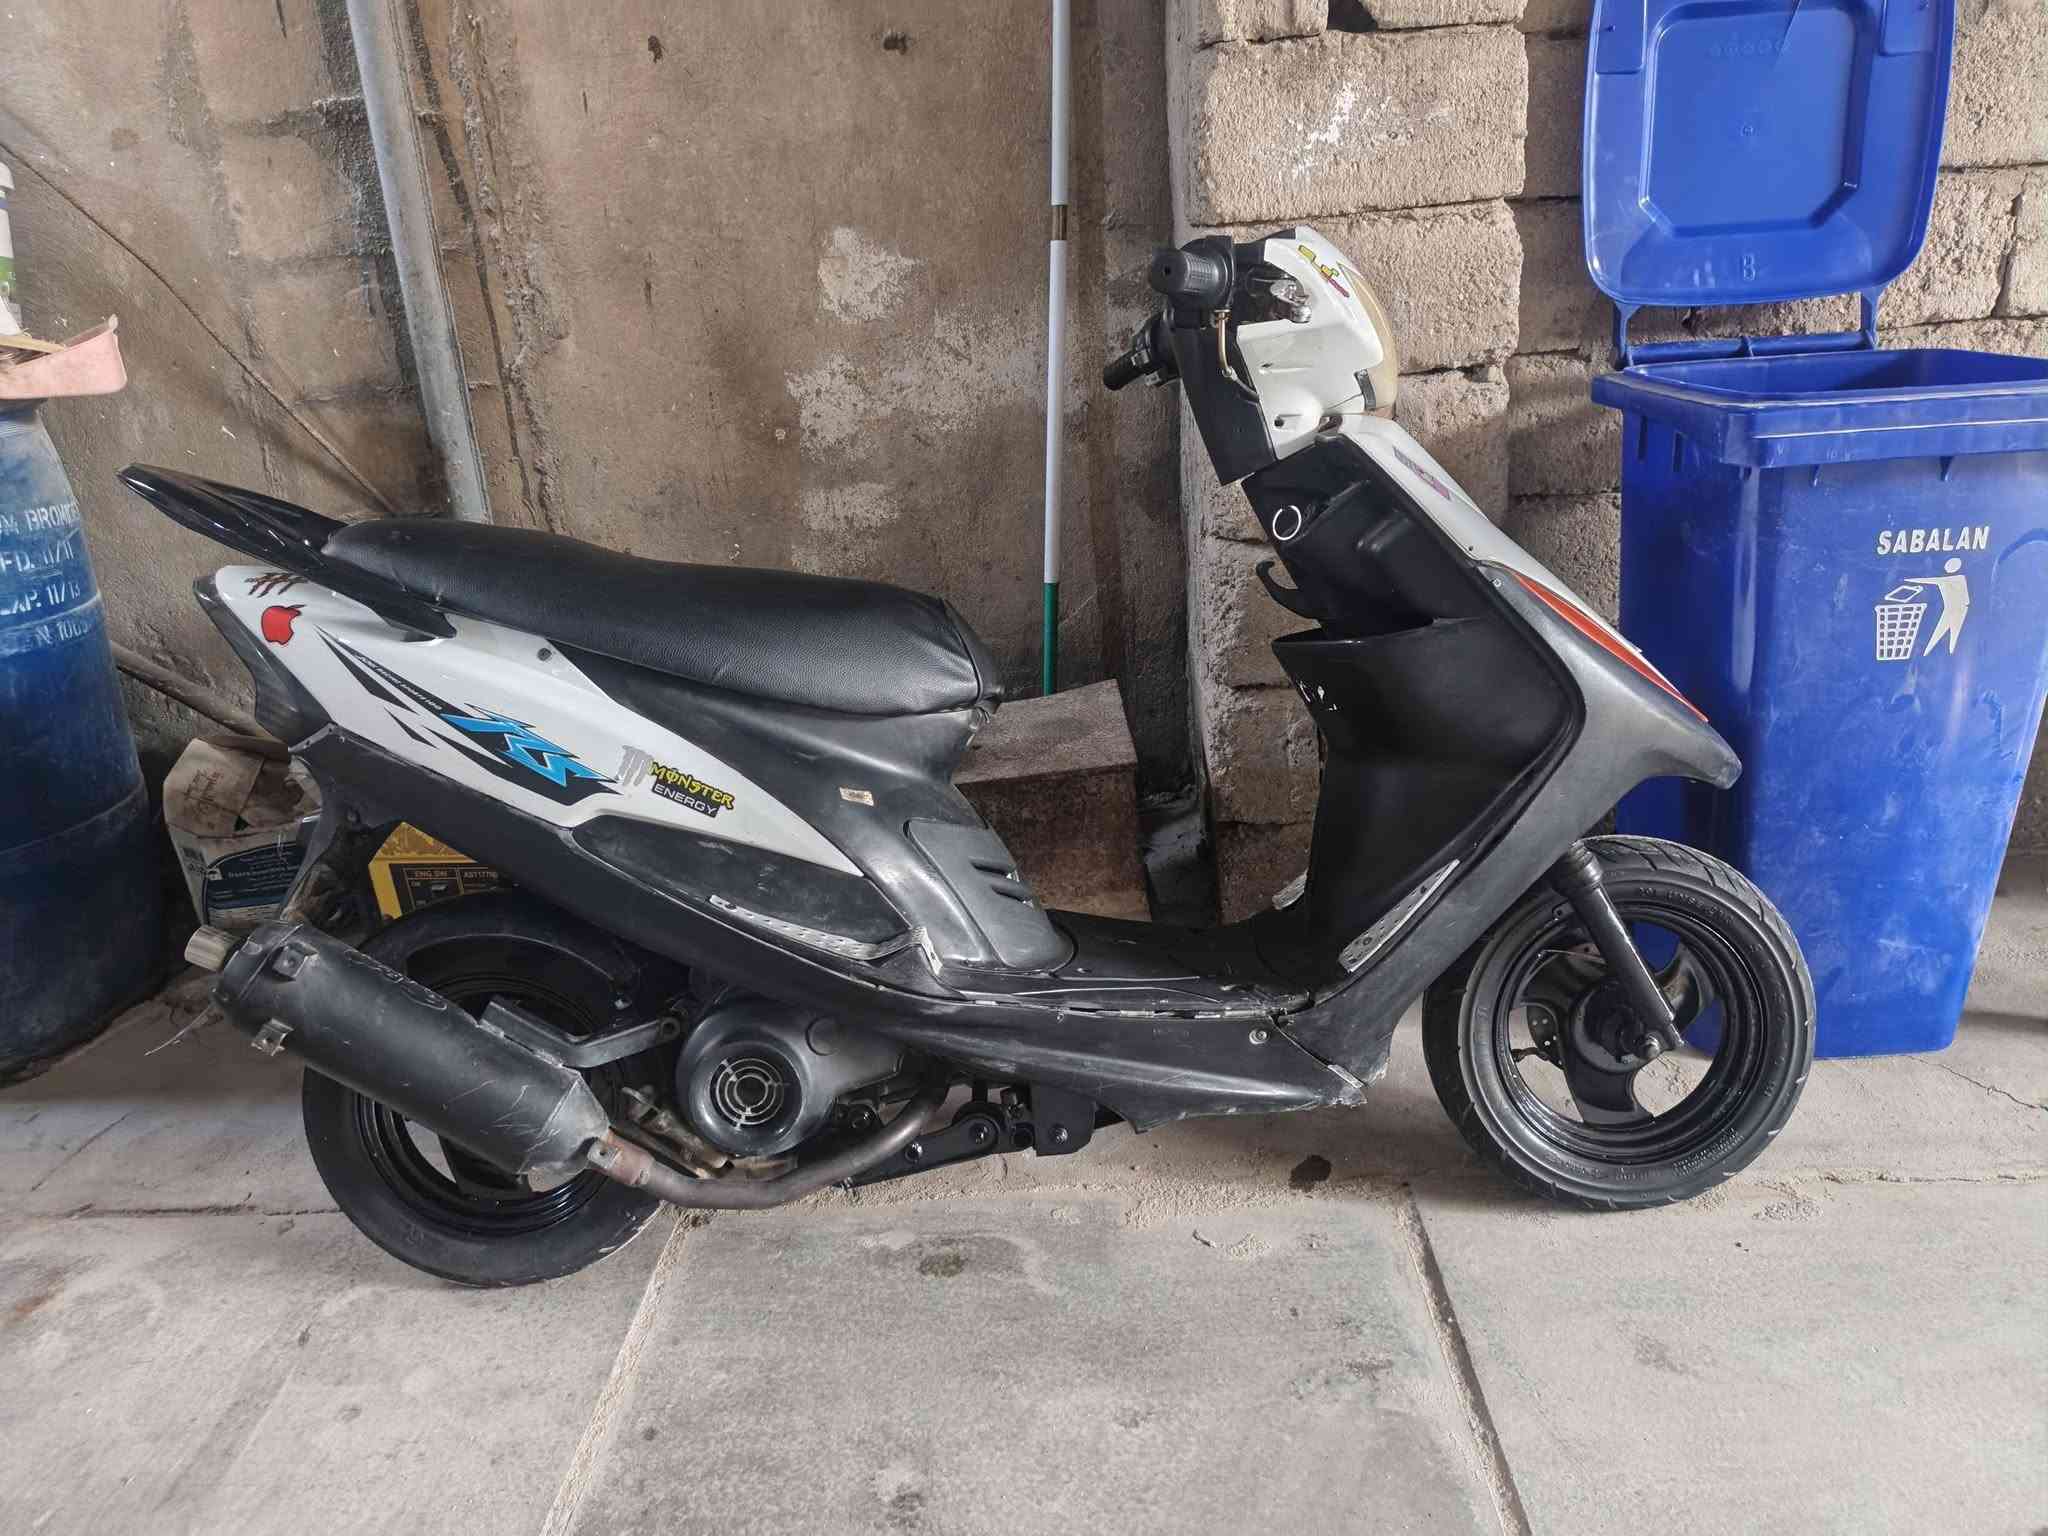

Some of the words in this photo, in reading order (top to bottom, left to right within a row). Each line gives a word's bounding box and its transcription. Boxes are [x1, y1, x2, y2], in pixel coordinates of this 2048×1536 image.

[1877, 526, 1990, 555] SABALAN
[651, 761, 736, 810] MONSTER
[653, 784, 719, 815] ENERGY
